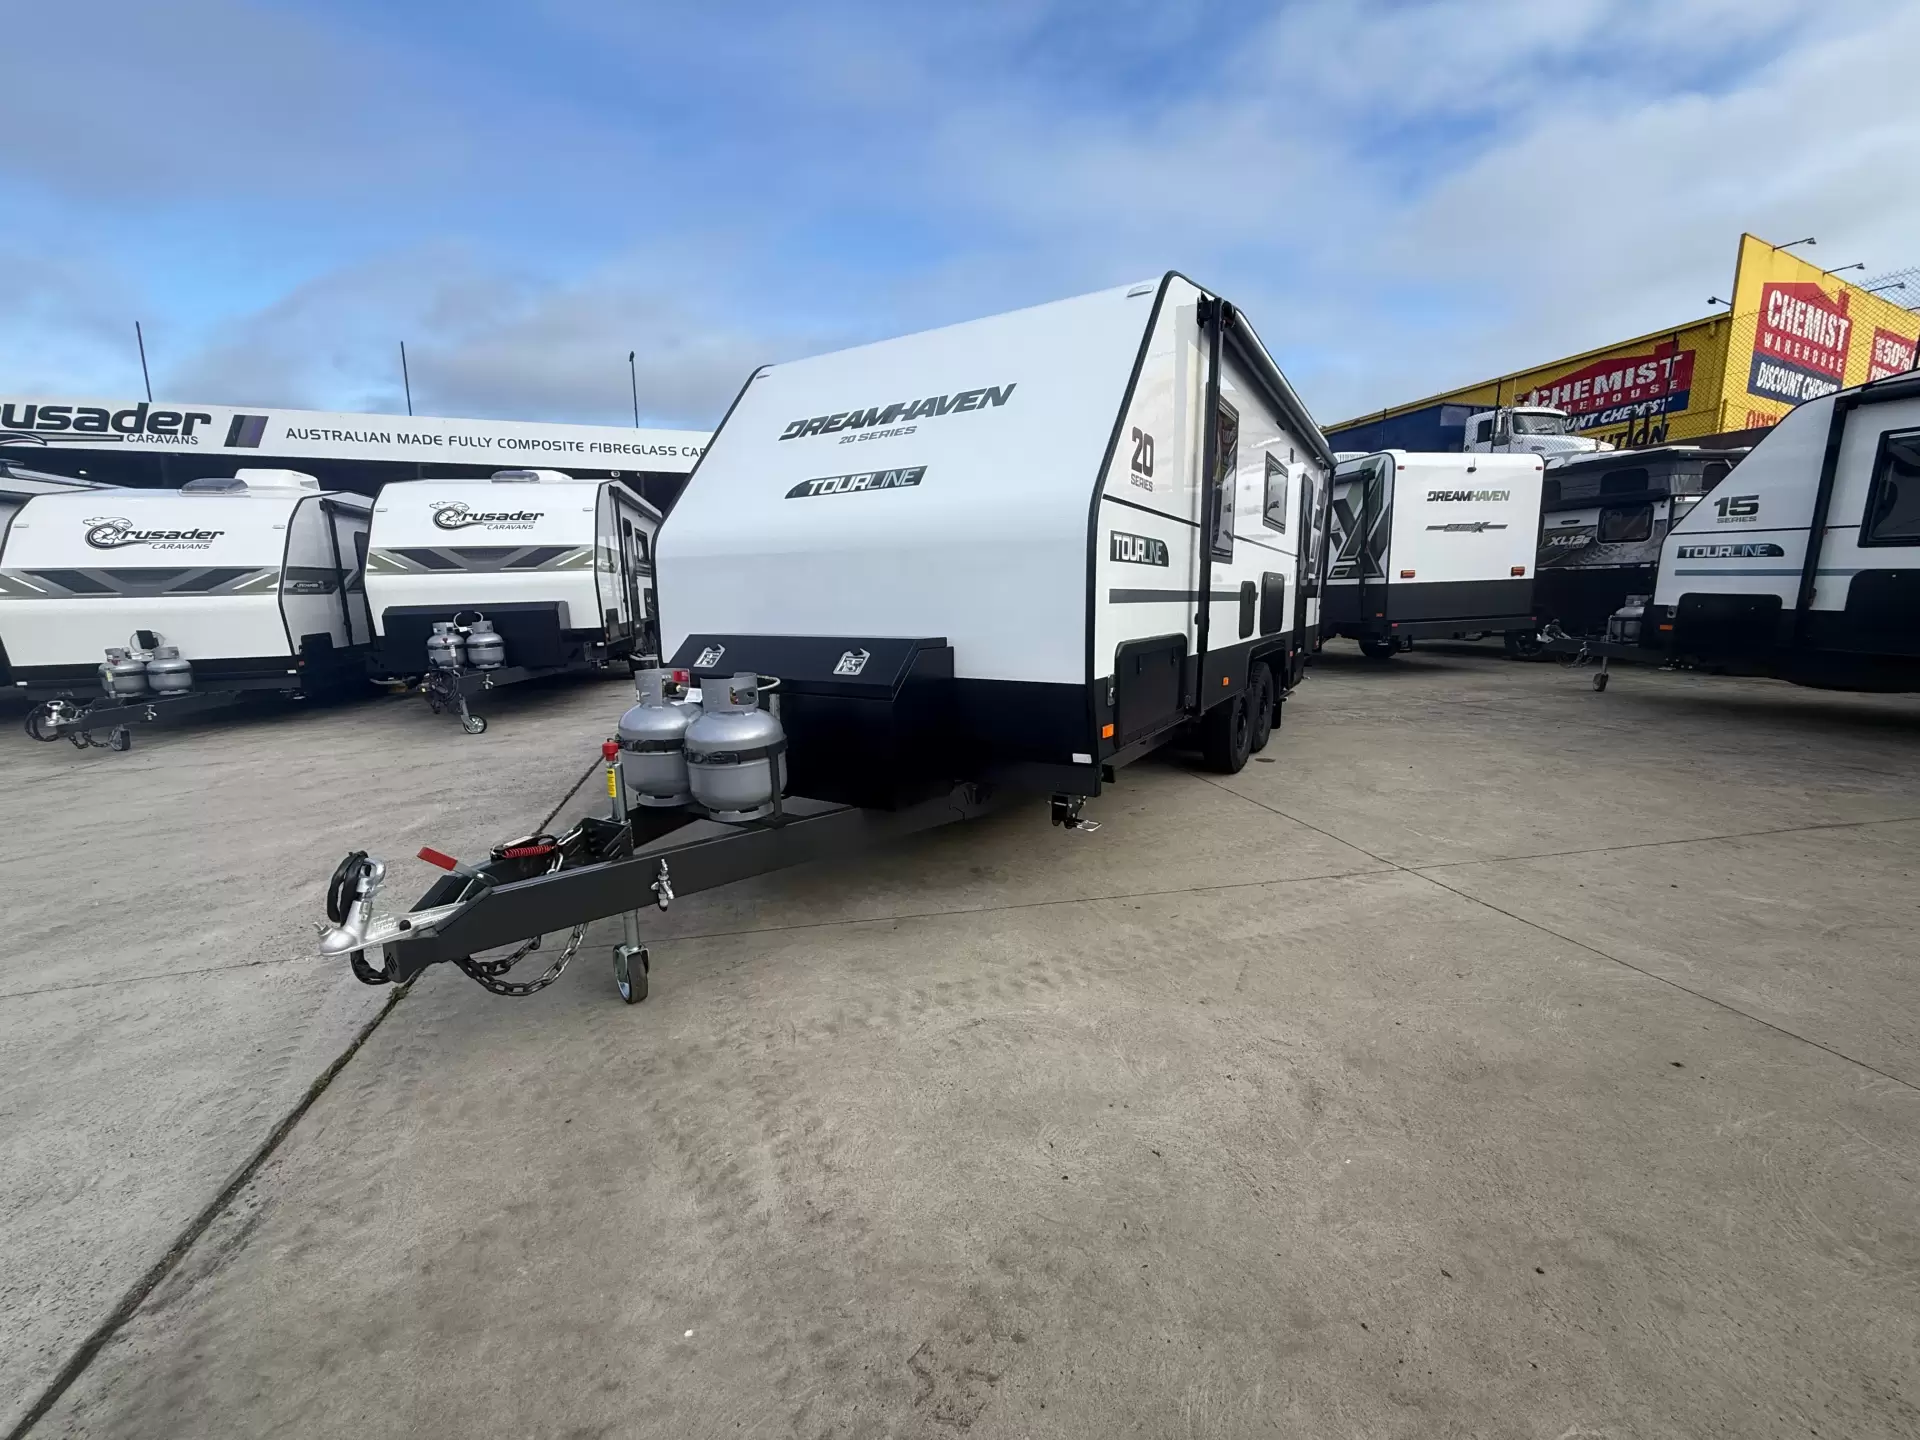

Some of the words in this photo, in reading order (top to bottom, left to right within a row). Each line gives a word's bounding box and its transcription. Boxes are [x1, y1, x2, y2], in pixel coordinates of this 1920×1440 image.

[1766, 289, 1849, 352] CHEMIST
[1763, 331, 1844, 373] WAREHOUSE
[1526, 354, 1684, 409] CHEMIST
[1756, 361, 1805, 398] DISCOUNT
[0, 402, 212, 436] usader
[778, 382, 1018, 441] DREAMHAVEN
[126, 432, 199, 446] CARAVANS
[286, 427, 391, 444] AUSTRALIAN
[397, 432, 443, 446] MADE
[449, 435, 493, 448] FULLY
[497, 437, 585, 452] COMPOSITE
[590, 442, 677, 456] FIBREGLASS
[838, 434, 856, 445] 20
[857, 425, 918, 442] SERIES
[1131, 426, 1155, 478] 20
[808, 467, 921, 496] TOURLINE
[1130, 473, 1154, 493] SERIES
[1426, 490, 1511, 502] DREAMHAVEN
[1713, 494, 1760, 517] 15
[1716, 516, 1757, 524] SERIES
[486, 523, 535, 531] CARAVANS
[151, 542, 211, 550] CARAVANS
[1114, 533, 1164, 566] TOURLINE
[1682, 543, 1769, 558] TOURLINE
